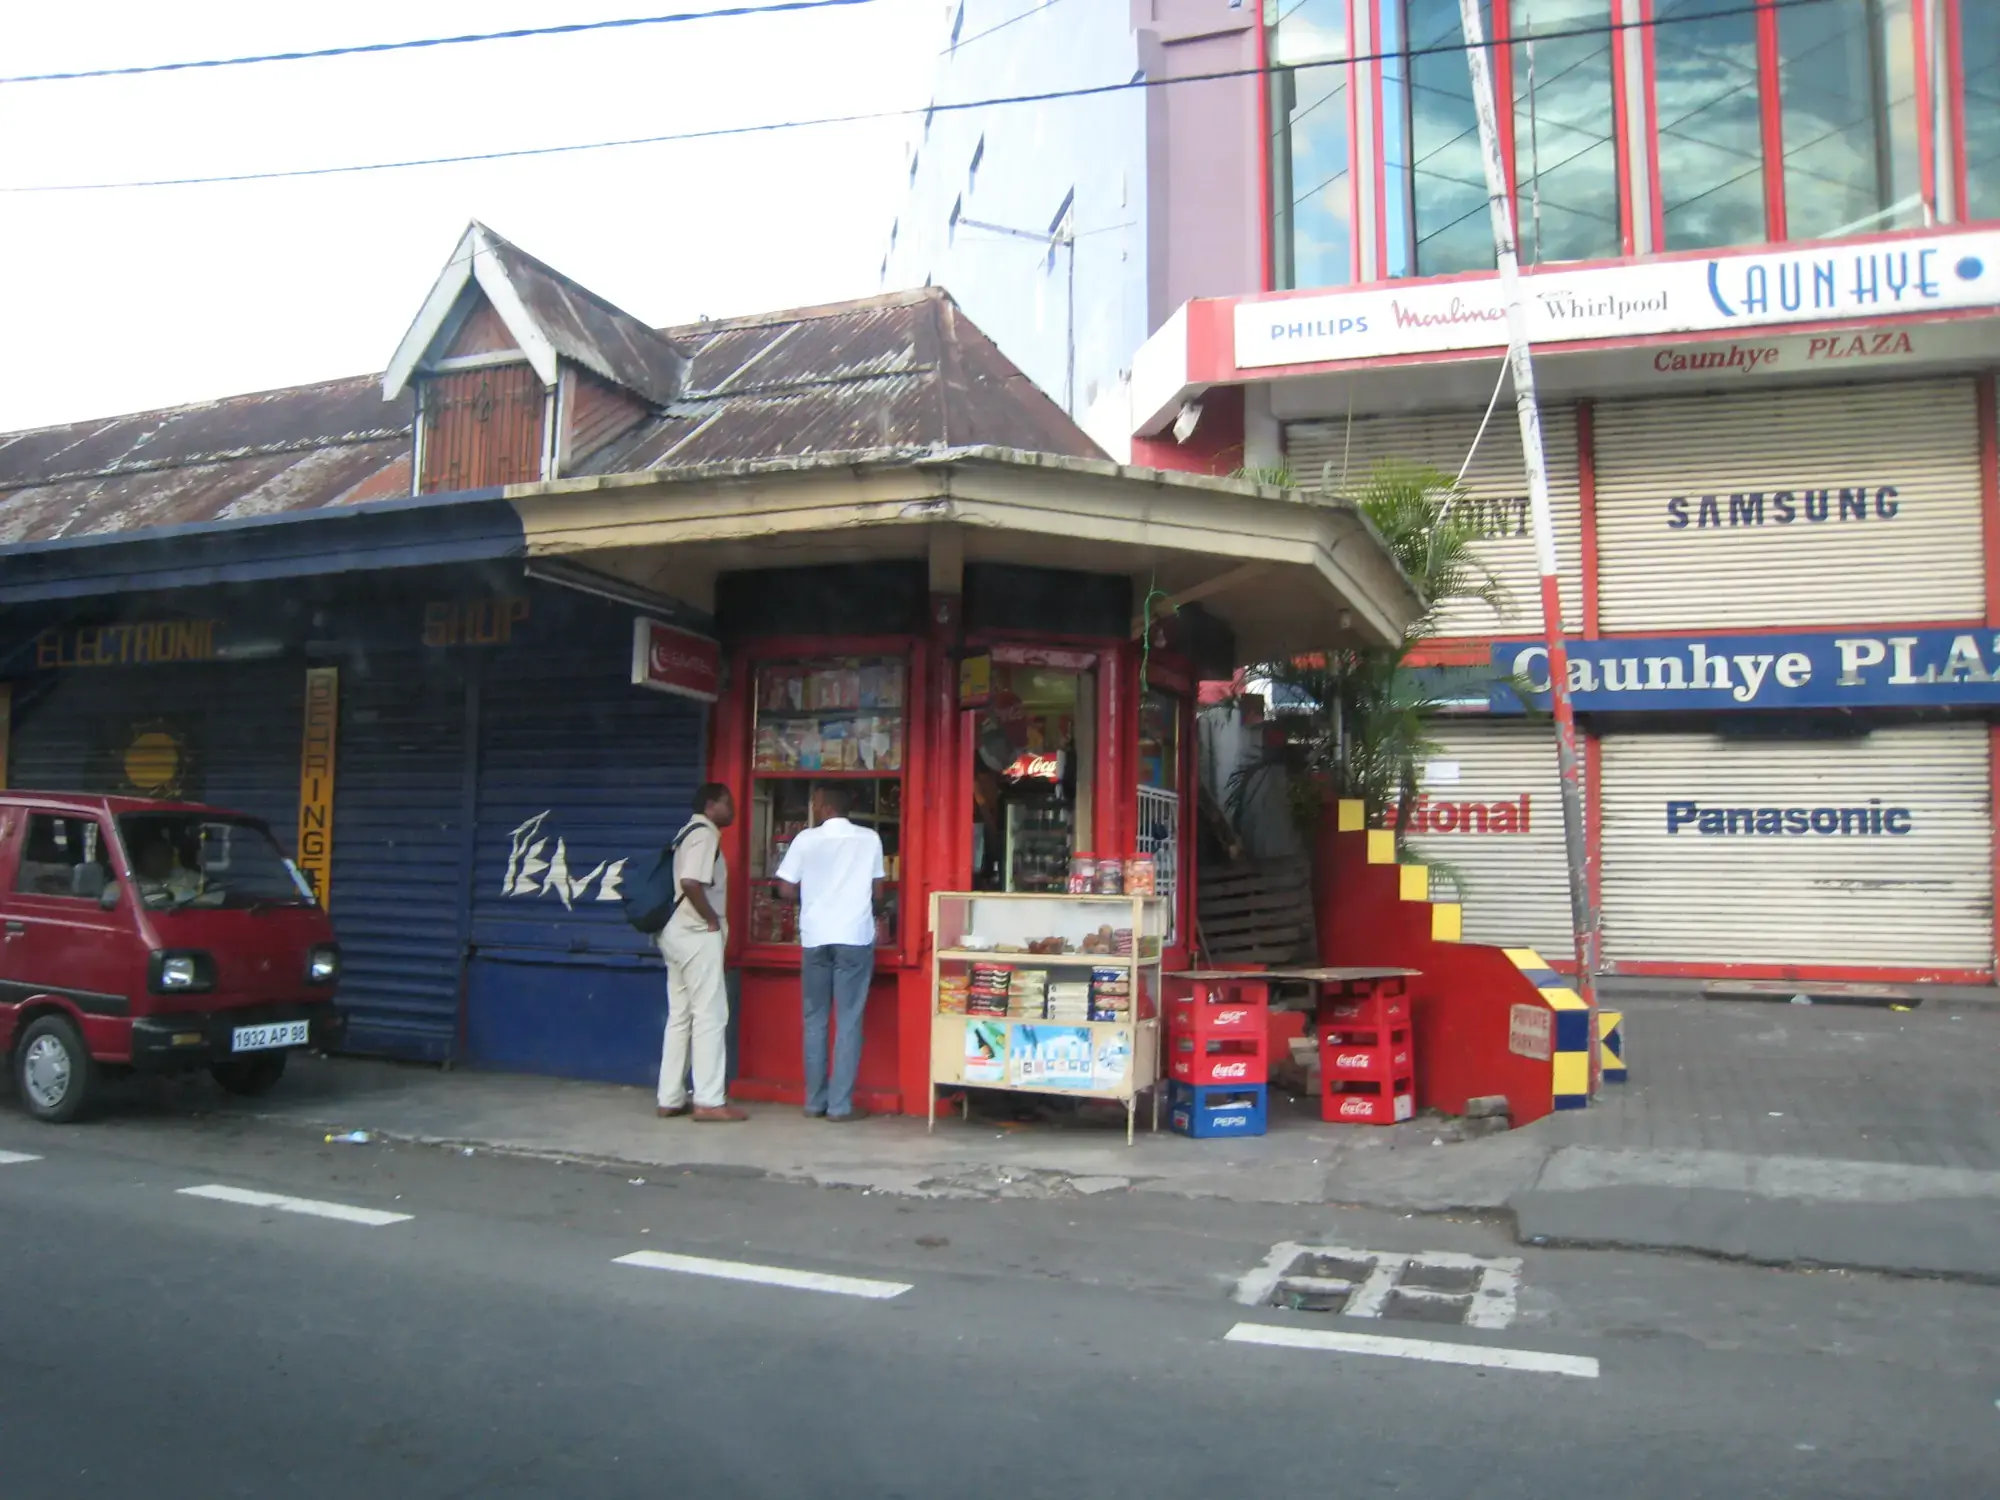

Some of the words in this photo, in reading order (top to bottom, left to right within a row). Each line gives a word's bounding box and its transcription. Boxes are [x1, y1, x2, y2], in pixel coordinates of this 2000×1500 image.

[1545, 291, 1667, 320] Whirlpool
[1272, 316, 1368, 340] PHILIPS
[1654, 345, 1779, 373] Caunhye
[1806, 332, 1914, 360] PLAZA
[1667, 486, 1899, 529] SAMSUNG
[1512, 643, 1813, 702] Caunhye
[1834, 633, 2000, 686] PLA
[1666, 798, 1912, 835] Panasonic
[236, 1030, 266, 1047] 1932
[269, 1027, 288, 1044] AP
[291, 1025, 305, 1041] 98
[1212, 1115, 1247, 1128] PEPSI
